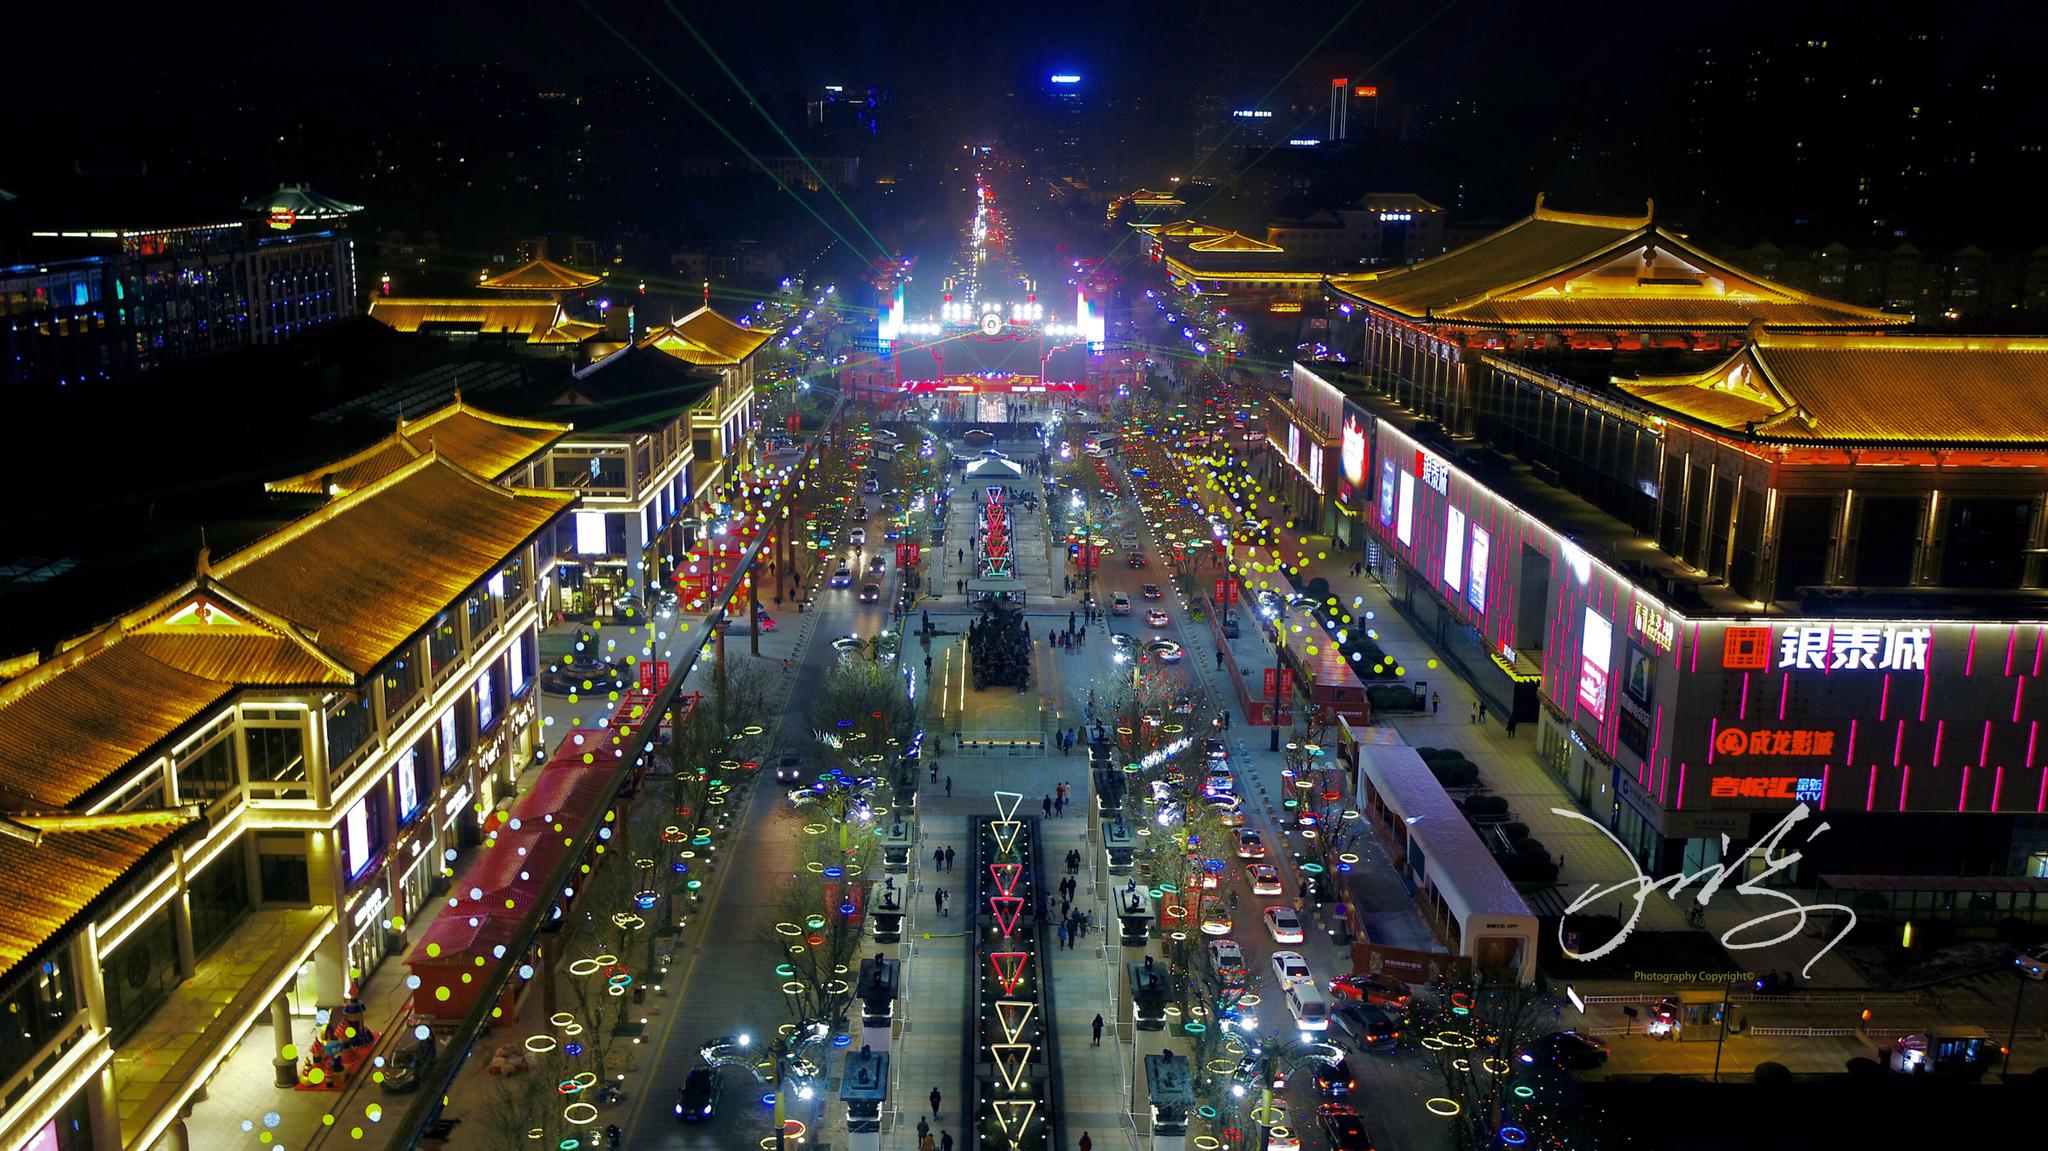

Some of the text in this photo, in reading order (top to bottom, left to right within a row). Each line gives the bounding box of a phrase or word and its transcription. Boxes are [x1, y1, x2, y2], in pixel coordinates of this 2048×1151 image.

[1778, 626, 1932, 670] 银泰城
[1748, 730, 1835, 755] 成龙影城
[1711, 776, 1798, 799] 音悦汇
[1796, 791, 1822, 801] KTV
[1568, 932, 1577, 945] P
